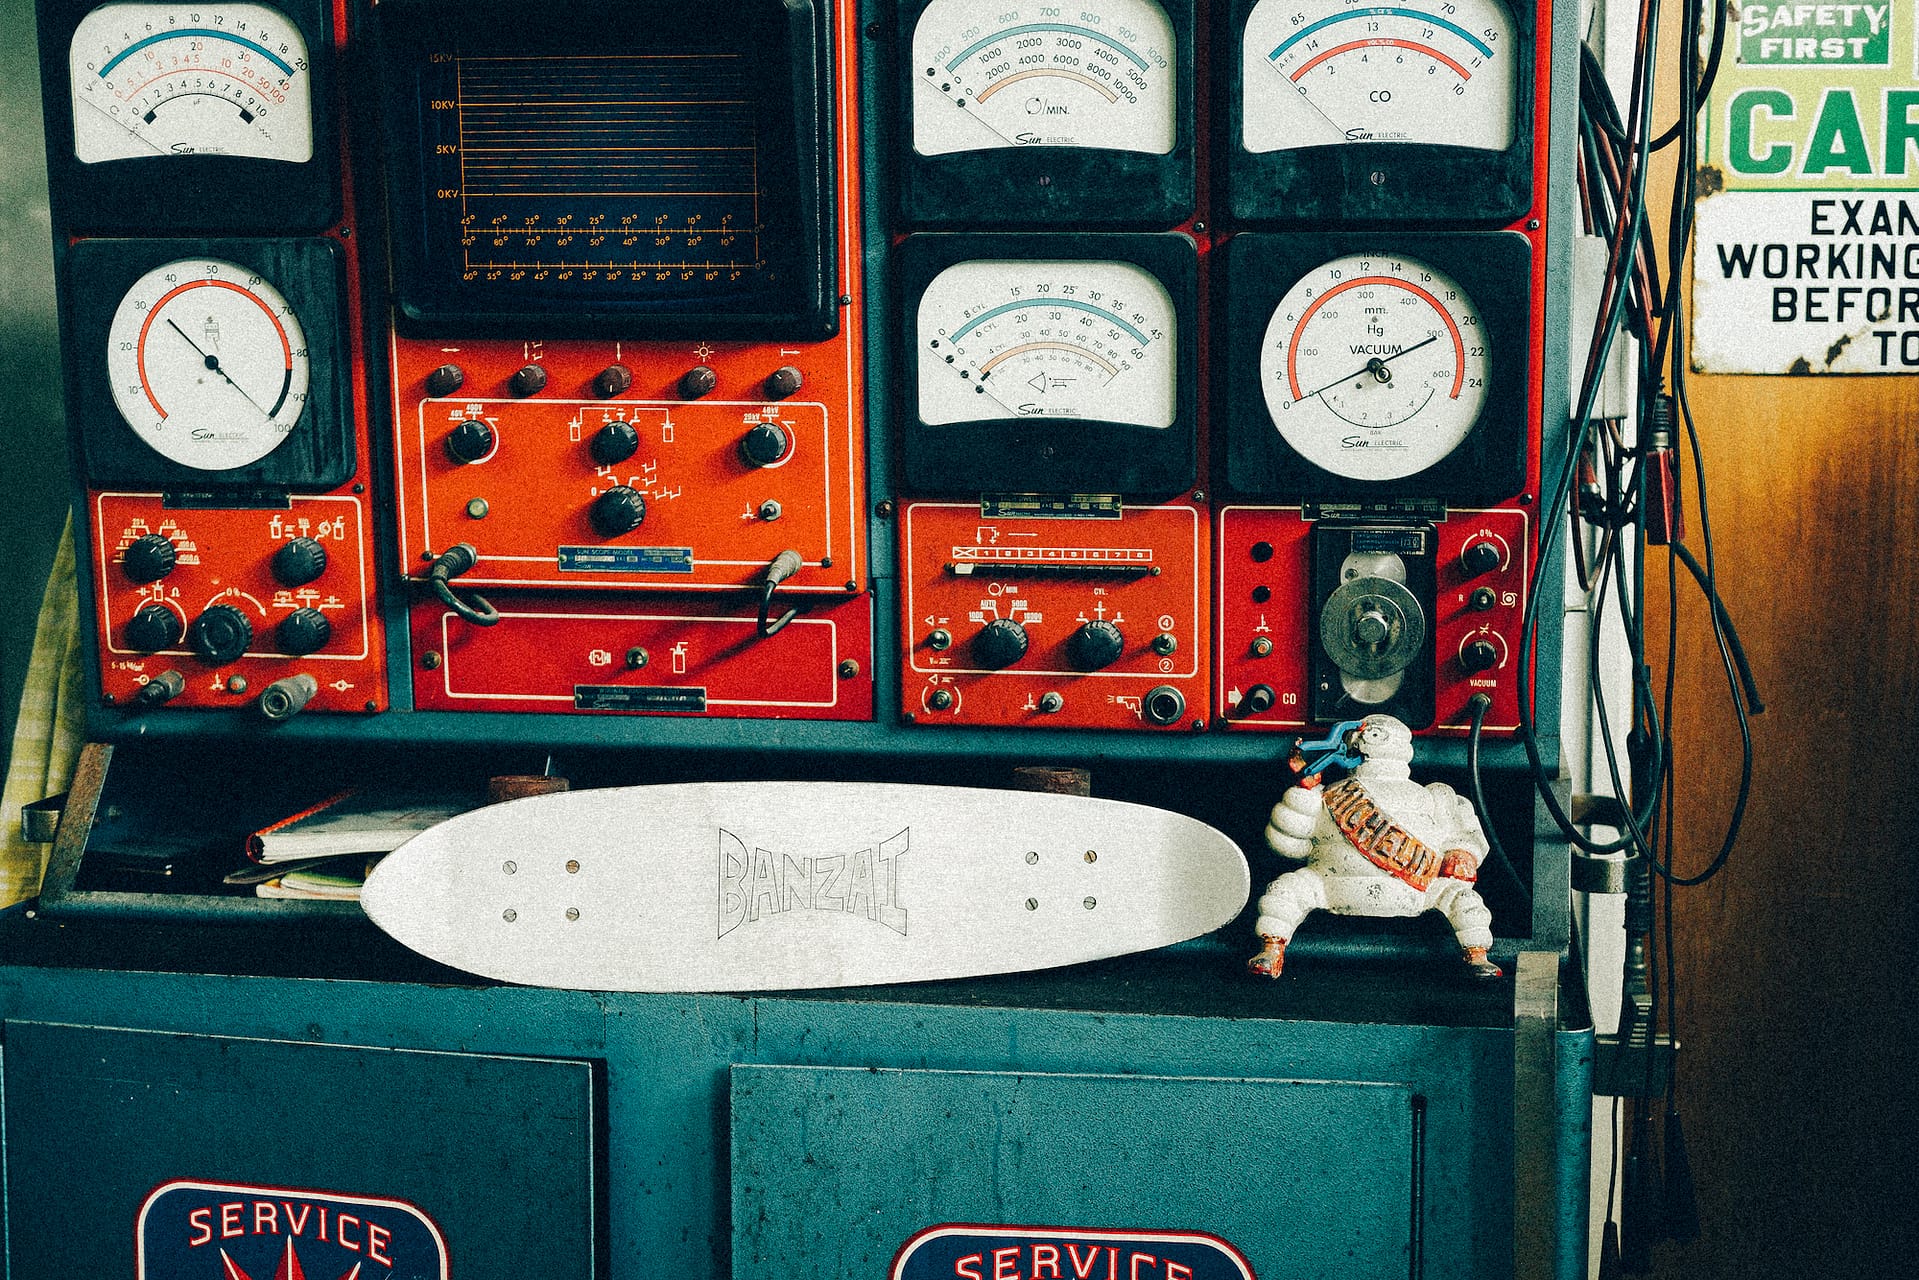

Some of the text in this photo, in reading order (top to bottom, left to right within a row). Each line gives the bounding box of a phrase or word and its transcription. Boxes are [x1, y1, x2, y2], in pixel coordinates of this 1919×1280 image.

[1291, 2, 1499, 41] 85 70 65
[1743, 5, 1888, 37] SAFETY
[87, 14, 308, 71] 0 2 4 6 8 10 12 14 16 18 20
[961, 26, 981, 42] 500
[998, 12, 1019, 24] 600
[1040, 7, 1060, 17] 700
[1080, 12, 1100, 24] 800
[1118, 26, 1137, 43] 900
[1146, 46, 1167, 70] 1000
[1306, 39, 1319, 52] 14
[1367, 22, 1379, 32] 13
[1422, 28, 1434, 39] 12
[1471, 58, 1482, 69] 11
[1760, 38, 1869, 60] FIRST
[106, 42, 290, 92] 0 20 30 40
[954, 37, 1148, 91] 0 1000 2000 3000 4000 5000
[966, 54, 1138, 106] 0 2000 4000 6000 8000 10000
[1298, 54, 1464, 96] 0 2 4 6 8 10
[1370, 90, 1391, 102] CO
[431, 100, 455, 110] 10KV
[1015, 133, 1042, 145] Sun
[1346, 128, 1373, 140] Sun
[170, 142, 195, 154] Sun
[436, 145, 457, 155] 5KV
[1360, 262, 1370, 271] 12
[1717, 244, 1919, 279] WORKING
[206, 266, 218, 274] 50
[1391, 263, 1402, 271] 14
[165, 274, 177, 282] 40
[1330, 271, 1341, 279] 10
[1421, 273, 1431, 282] 16
[249, 277, 261, 285] 60
[1306, 289, 1312, 297] 8
[1446, 291, 1456, 300] 18
[135, 301, 147, 309] 30
[1400, 298, 1417, 306] 400
[1365, 307, 1389, 315] mm.
[939, 328, 946, 336] 0
[964, 310, 970, 318] 8
[1463, 317, 1477, 325] 20
[1367, 325, 1384, 337] Hg
[120, 343, 132, 351] 20
[958, 348, 965, 356] 0
[976, 329, 982, 338] 6
[1350, 345, 1402, 355] VACUUM
[1471, 348, 1485, 356] 22
[1873, 331, 1919, 365] TO
[1277, 372, 1282, 380] 2
[1469, 379, 1482, 388] 24
[129, 386, 138, 394] 10
[1018, 403, 1044, 415] Sun
[1283, 401, 1290, 409] 0
[156, 423, 162, 431] 0
[274, 424, 291, 432] 100
[192, 429, 215, 440] Sun
[1341, 436, 1369, 448] Sun
[1459, 594, 1464, 602] R
[1469, 679, 1497, 688] VACUUM
[1283, 693, 1297, 705] CO
[1323, 778, 1436, 879] MICHELIN
[718, 827, 909, 940] BANZAI
[189, 1200, 393, 1268] SERVICE
